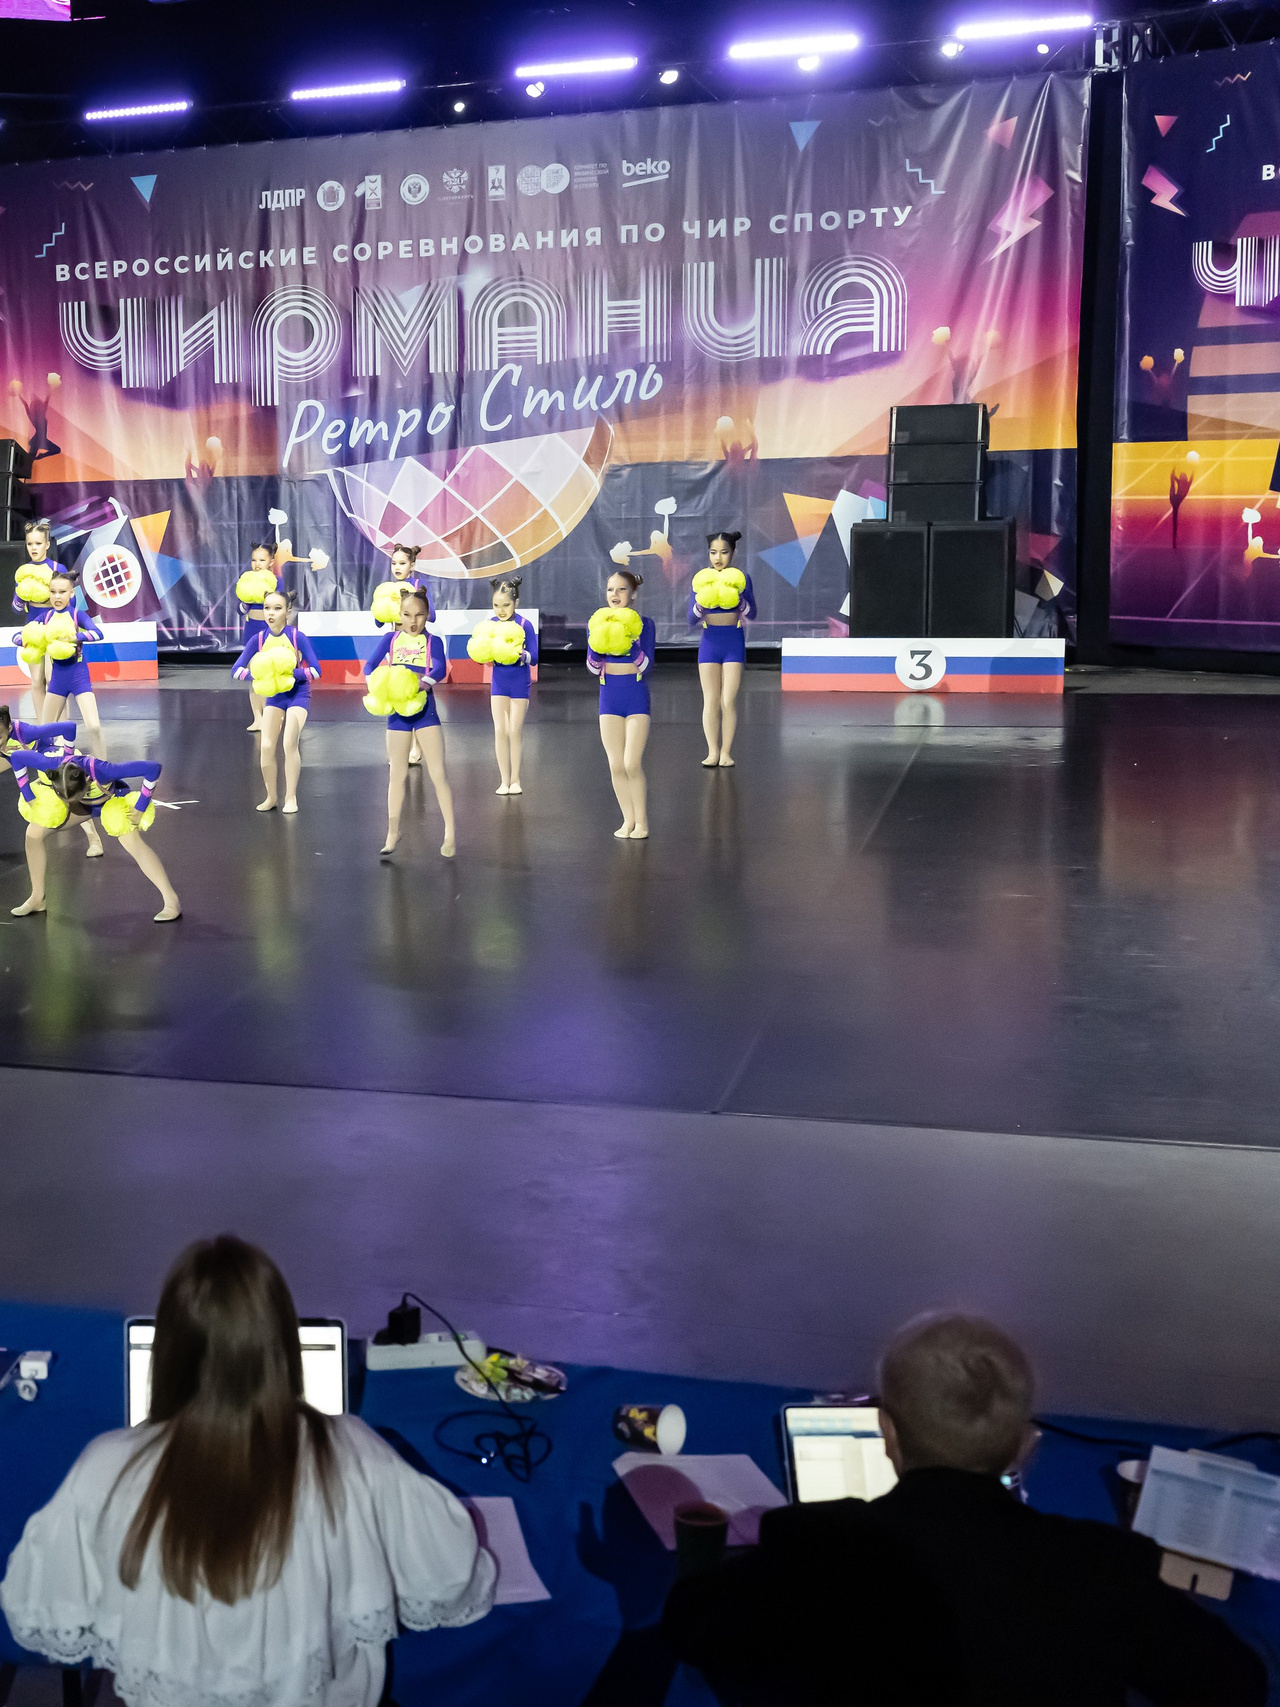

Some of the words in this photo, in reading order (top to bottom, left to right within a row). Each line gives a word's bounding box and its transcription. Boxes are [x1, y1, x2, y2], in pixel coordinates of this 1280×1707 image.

[622, 158, 670, 176] beko
[259, 188, 305, 211] ЛДПР
[55, 247, 318, 282] ВСЕРОССИЙСКИЕ
[333, 227, 602, 263] СОРЕВНОВАНИЯ
[620, 223, 665, 244] ПО
[683, 217, 751, 239] ЧИР
[770, 205, 913, 234] СПОРТУ
[282, 399, 454, 467] Ретро
[479, 364, 665, 432] Стиль
[909, 650, 932, 680] 3
